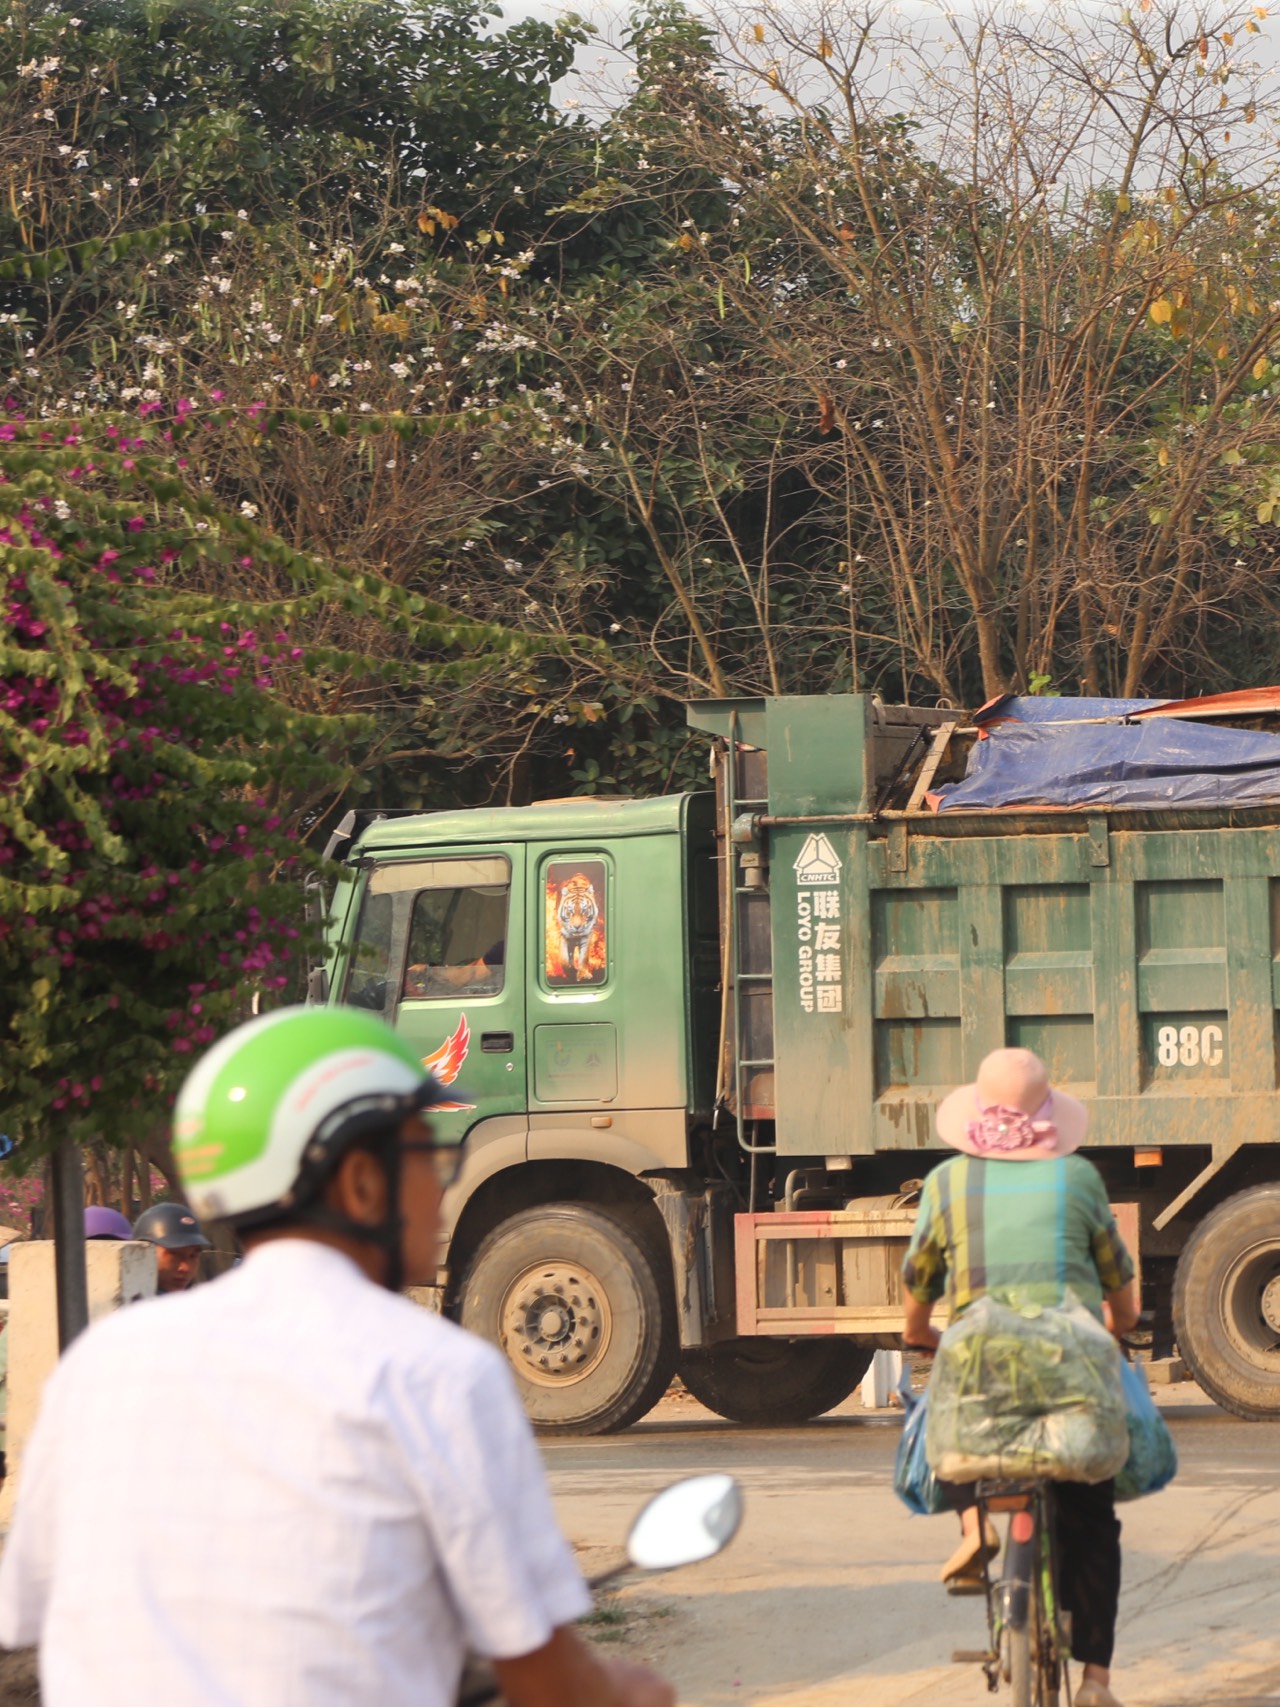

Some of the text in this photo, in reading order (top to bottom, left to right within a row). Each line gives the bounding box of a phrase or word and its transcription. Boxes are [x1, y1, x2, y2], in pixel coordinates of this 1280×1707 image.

[800, 873, 836, 882] CNHTC
[797, 891, 814, 1013] LOYO GROUP
[813, 890, 842, 1013] 联友集团
[1157, 1025, 1223, 1067] 88C
